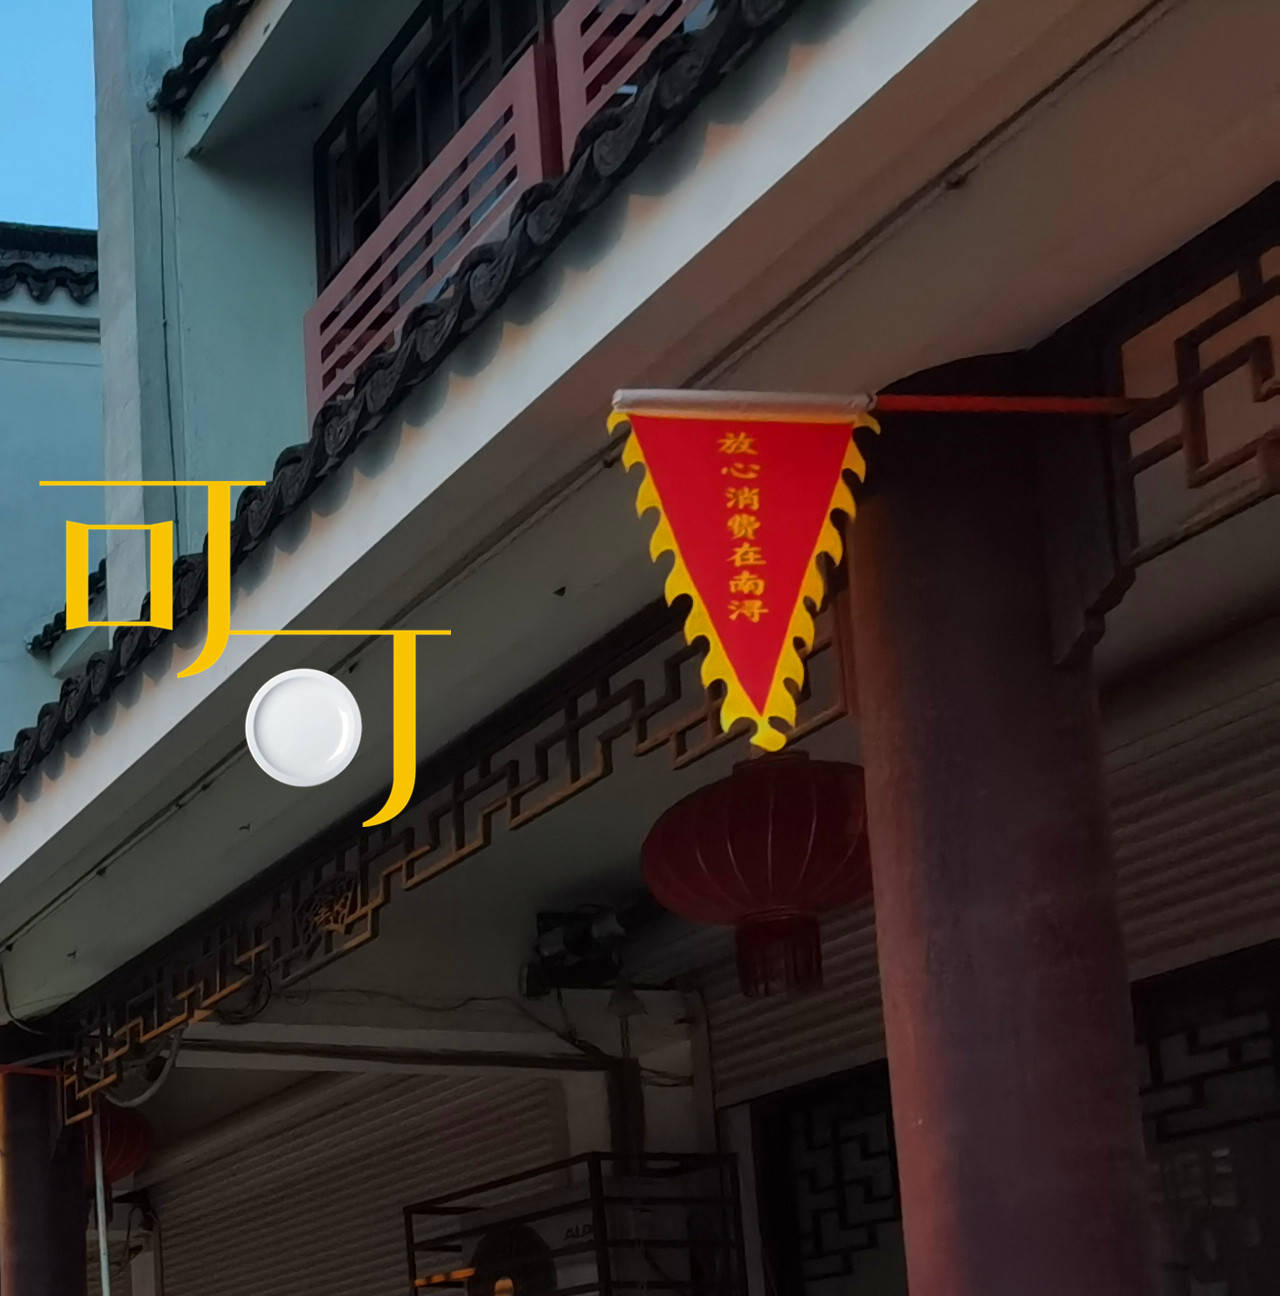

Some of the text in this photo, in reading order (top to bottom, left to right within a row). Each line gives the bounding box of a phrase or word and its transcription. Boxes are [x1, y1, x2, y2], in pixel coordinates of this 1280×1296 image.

[717, 431, 769, 623] 放心消费在南浔
